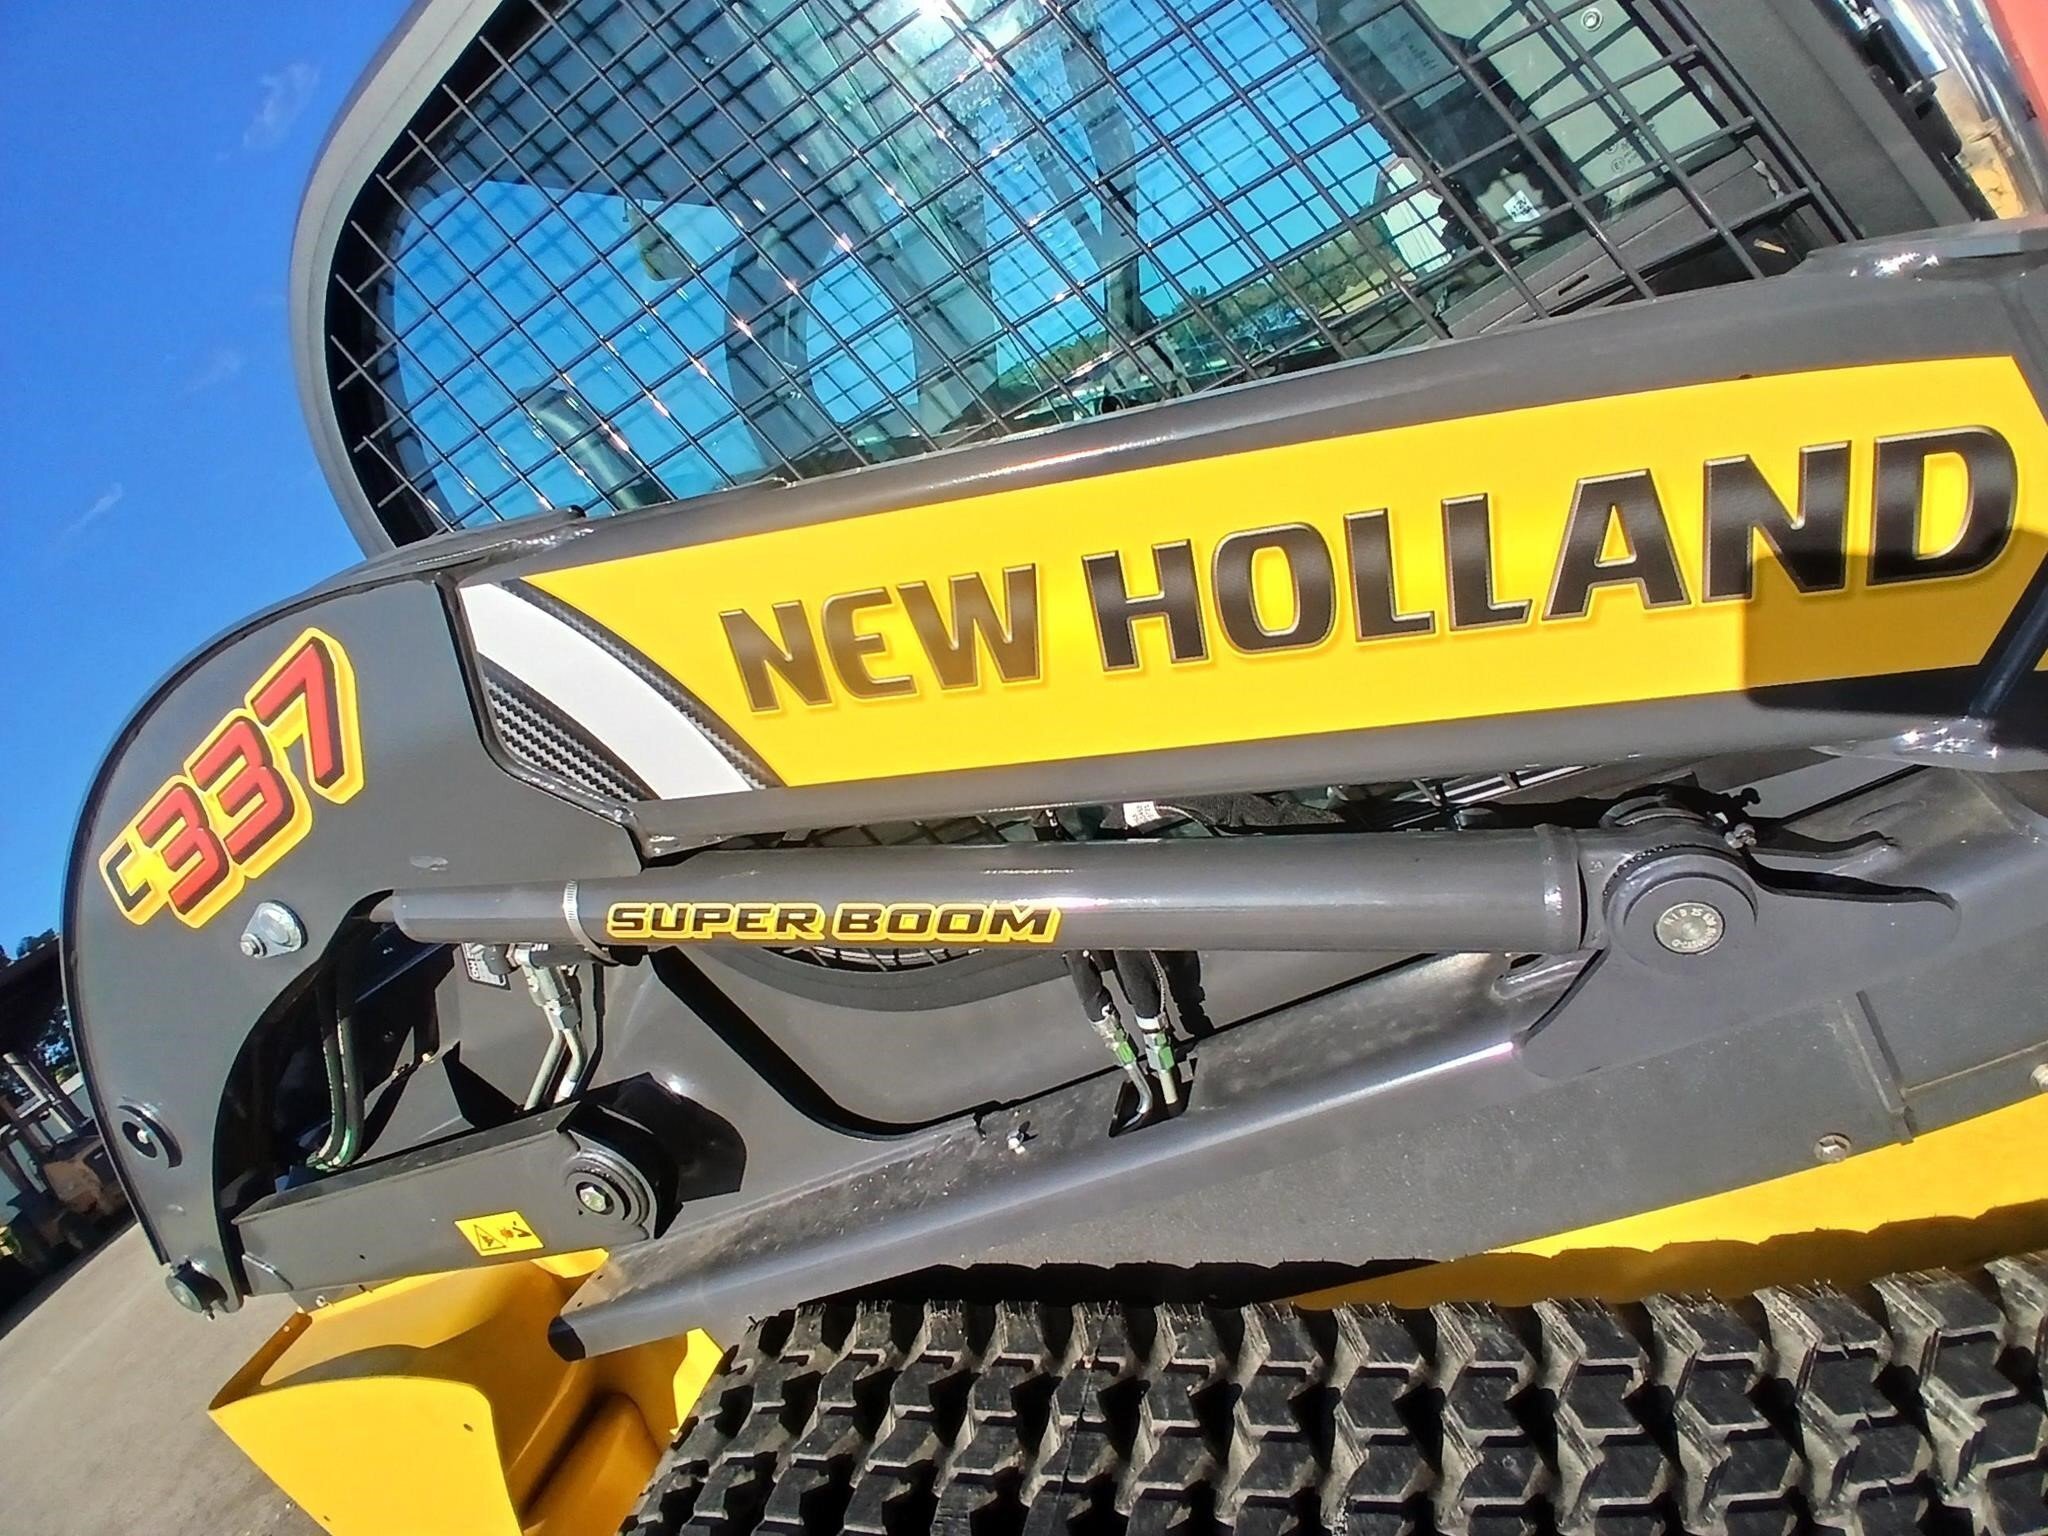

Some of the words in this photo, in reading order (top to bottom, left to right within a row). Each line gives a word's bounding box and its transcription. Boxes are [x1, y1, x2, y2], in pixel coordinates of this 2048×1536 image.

[719, 562, 1042, 713] NEW
[1081, 424, 2019, 673] HOLLAND
[100, 629, 361, 924] C337
[608, 904, 823, 937] SUPER
[834, 903, 1060, 940] BOOM
